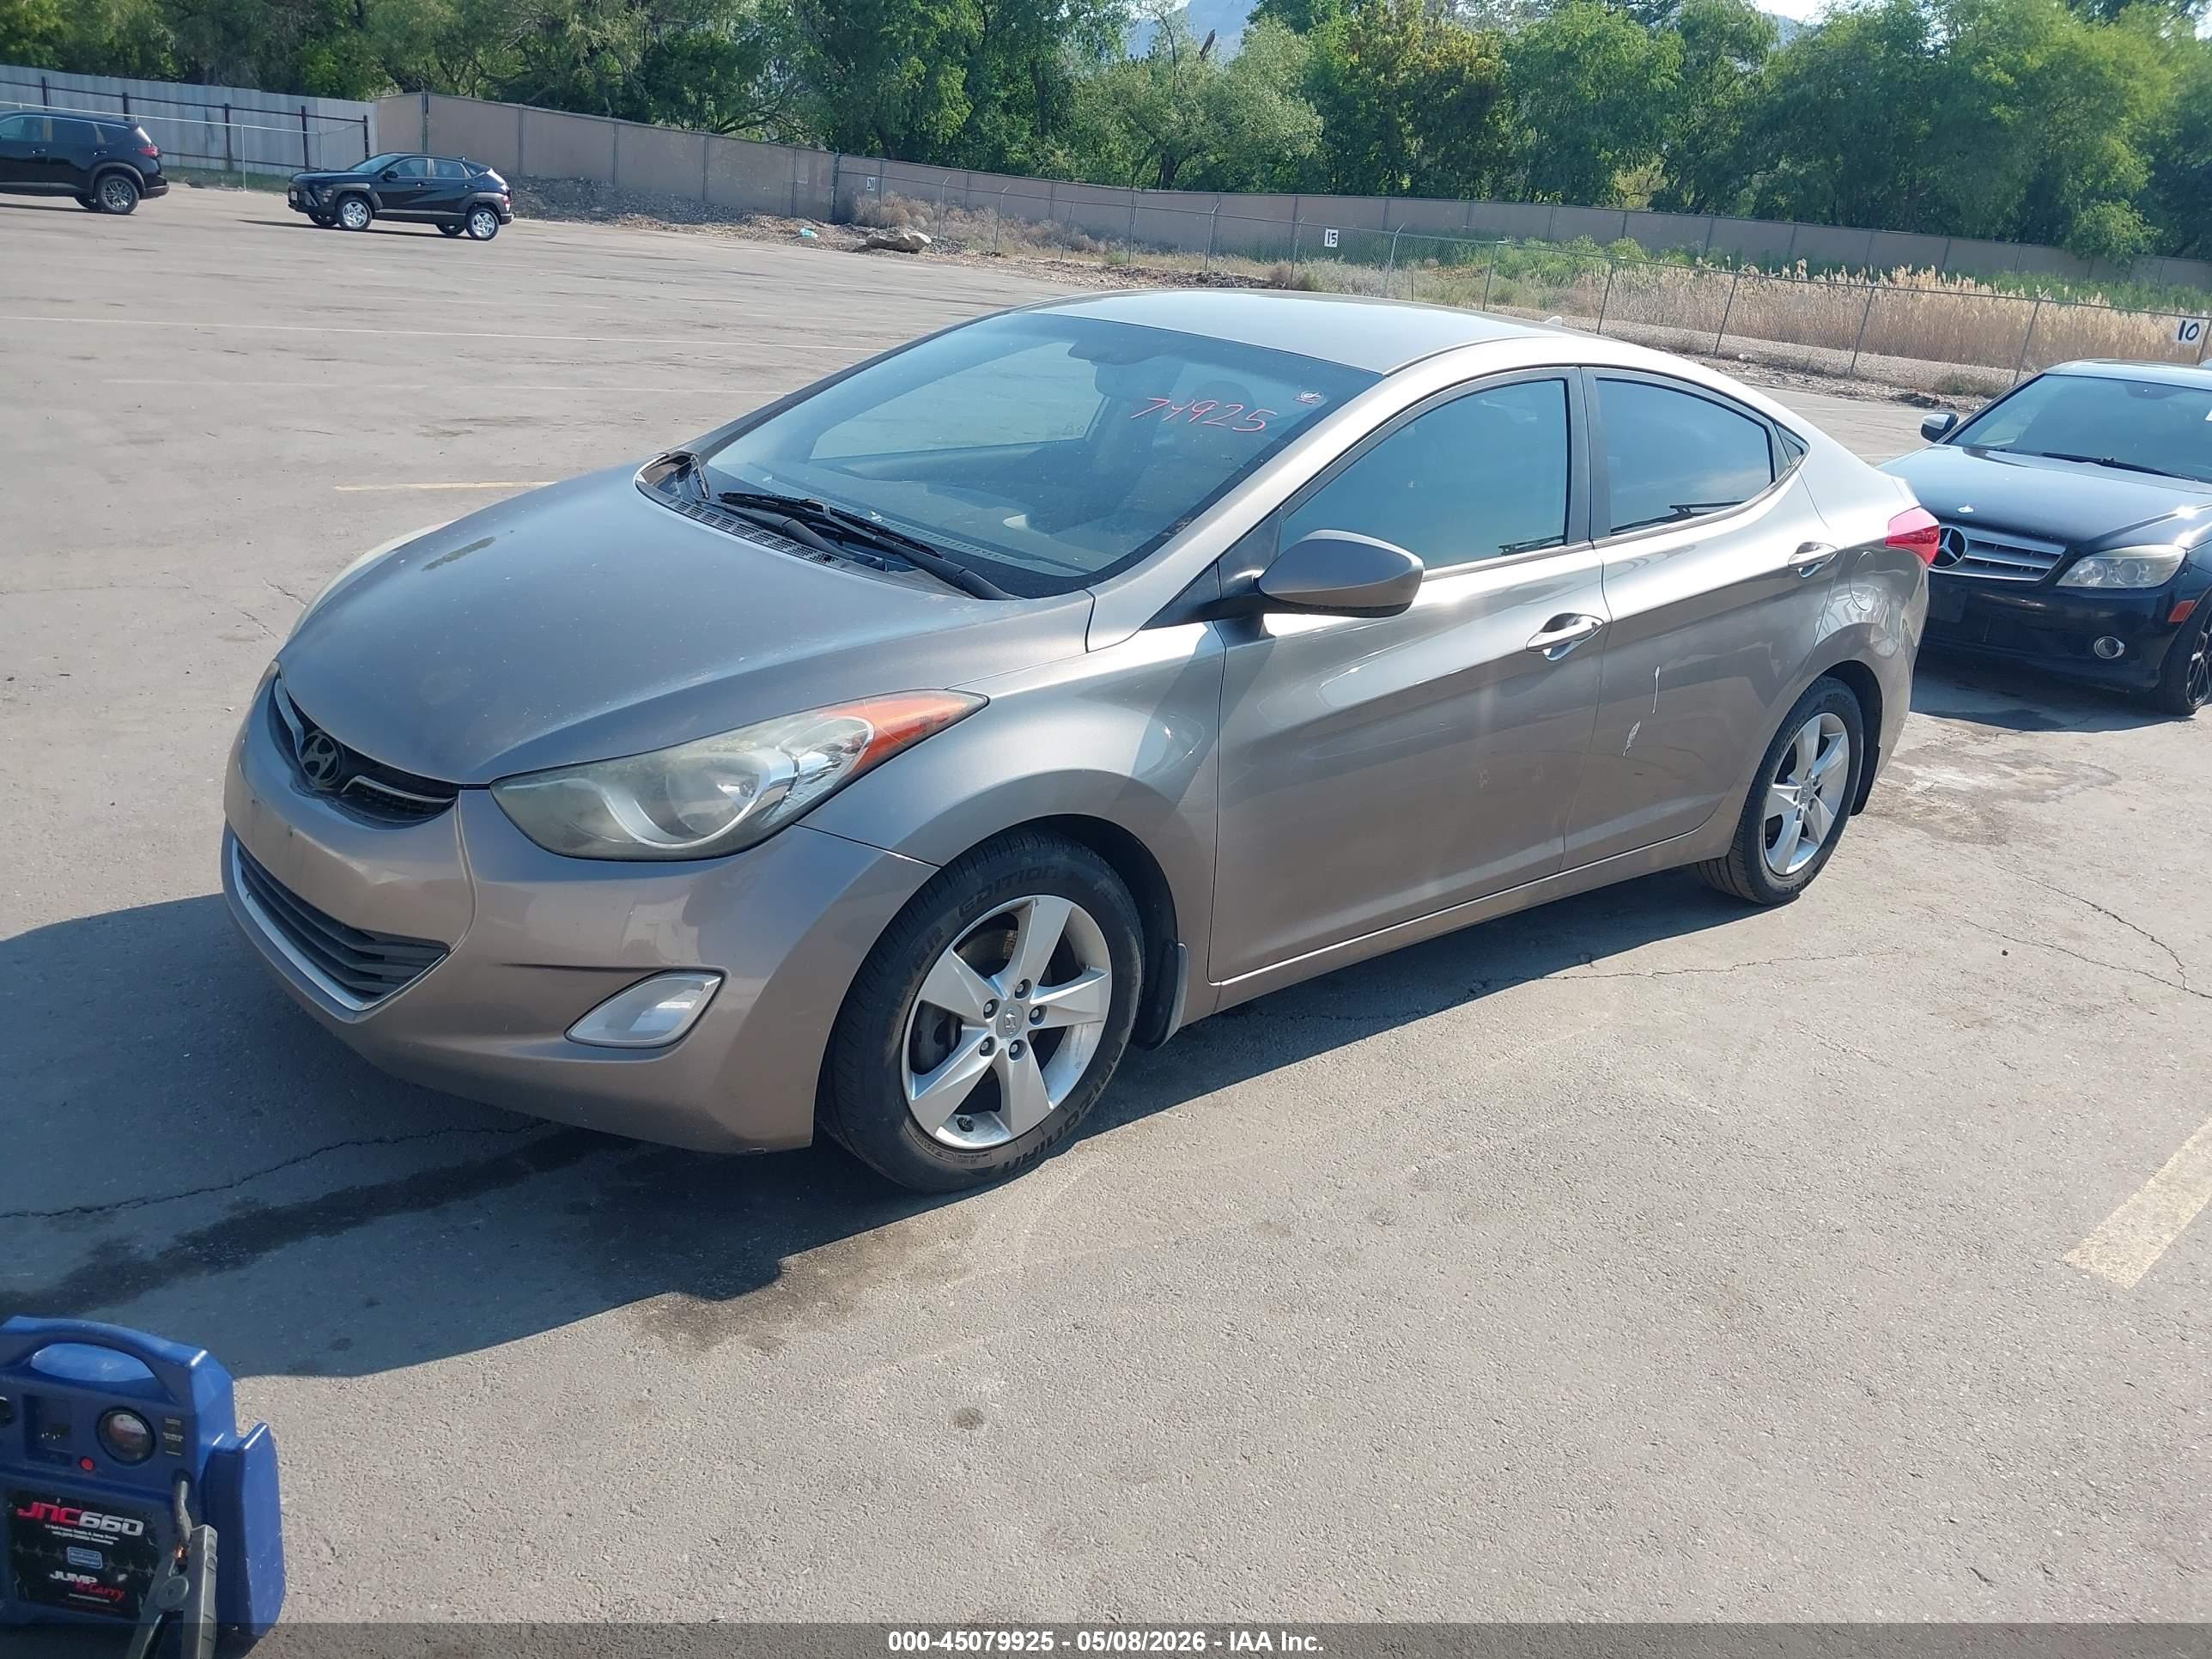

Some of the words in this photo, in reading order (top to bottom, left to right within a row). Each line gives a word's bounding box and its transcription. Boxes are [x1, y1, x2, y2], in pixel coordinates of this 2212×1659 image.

[1327, 231, 1337, 245] 15
[2178, 320, 2200, 341] 10
[49, 1570, 98, 1585] JUMP
